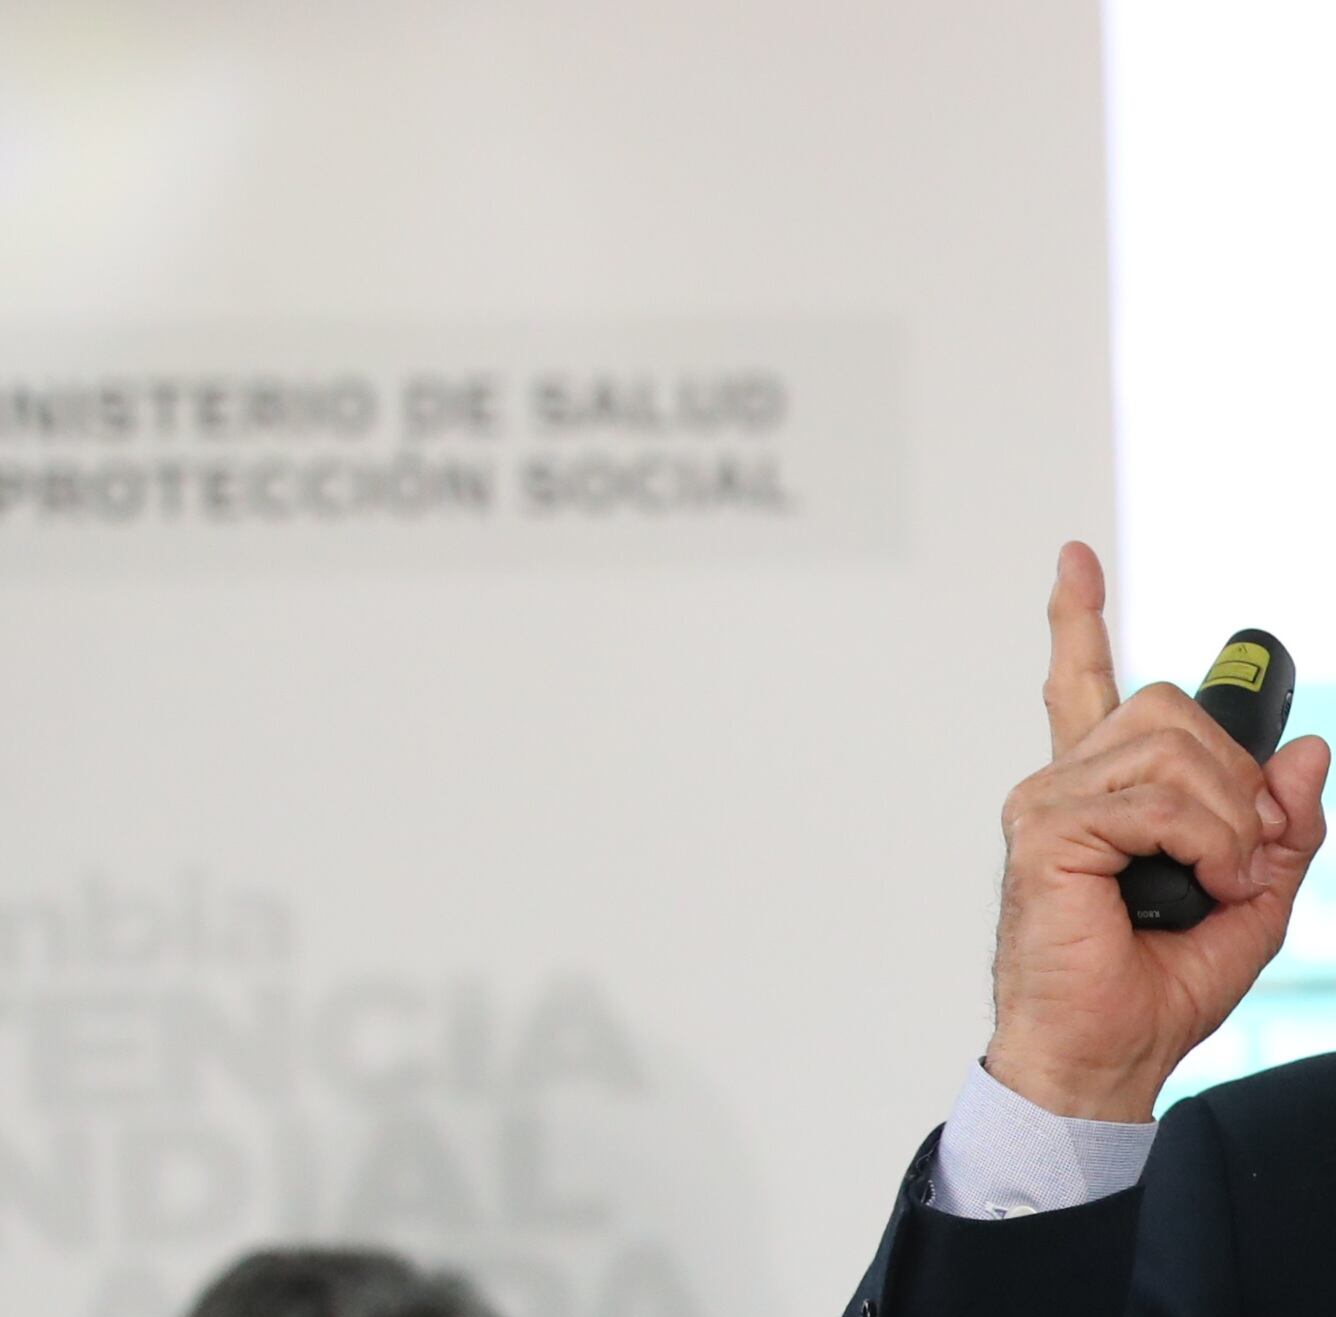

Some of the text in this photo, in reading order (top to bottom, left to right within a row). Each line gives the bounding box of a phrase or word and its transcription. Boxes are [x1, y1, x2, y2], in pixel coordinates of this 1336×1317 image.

[397, 372, 496, 437] DE
[531, 370, 788, 434] SALUD
[522, 449, 798, 517] SOCIAL
